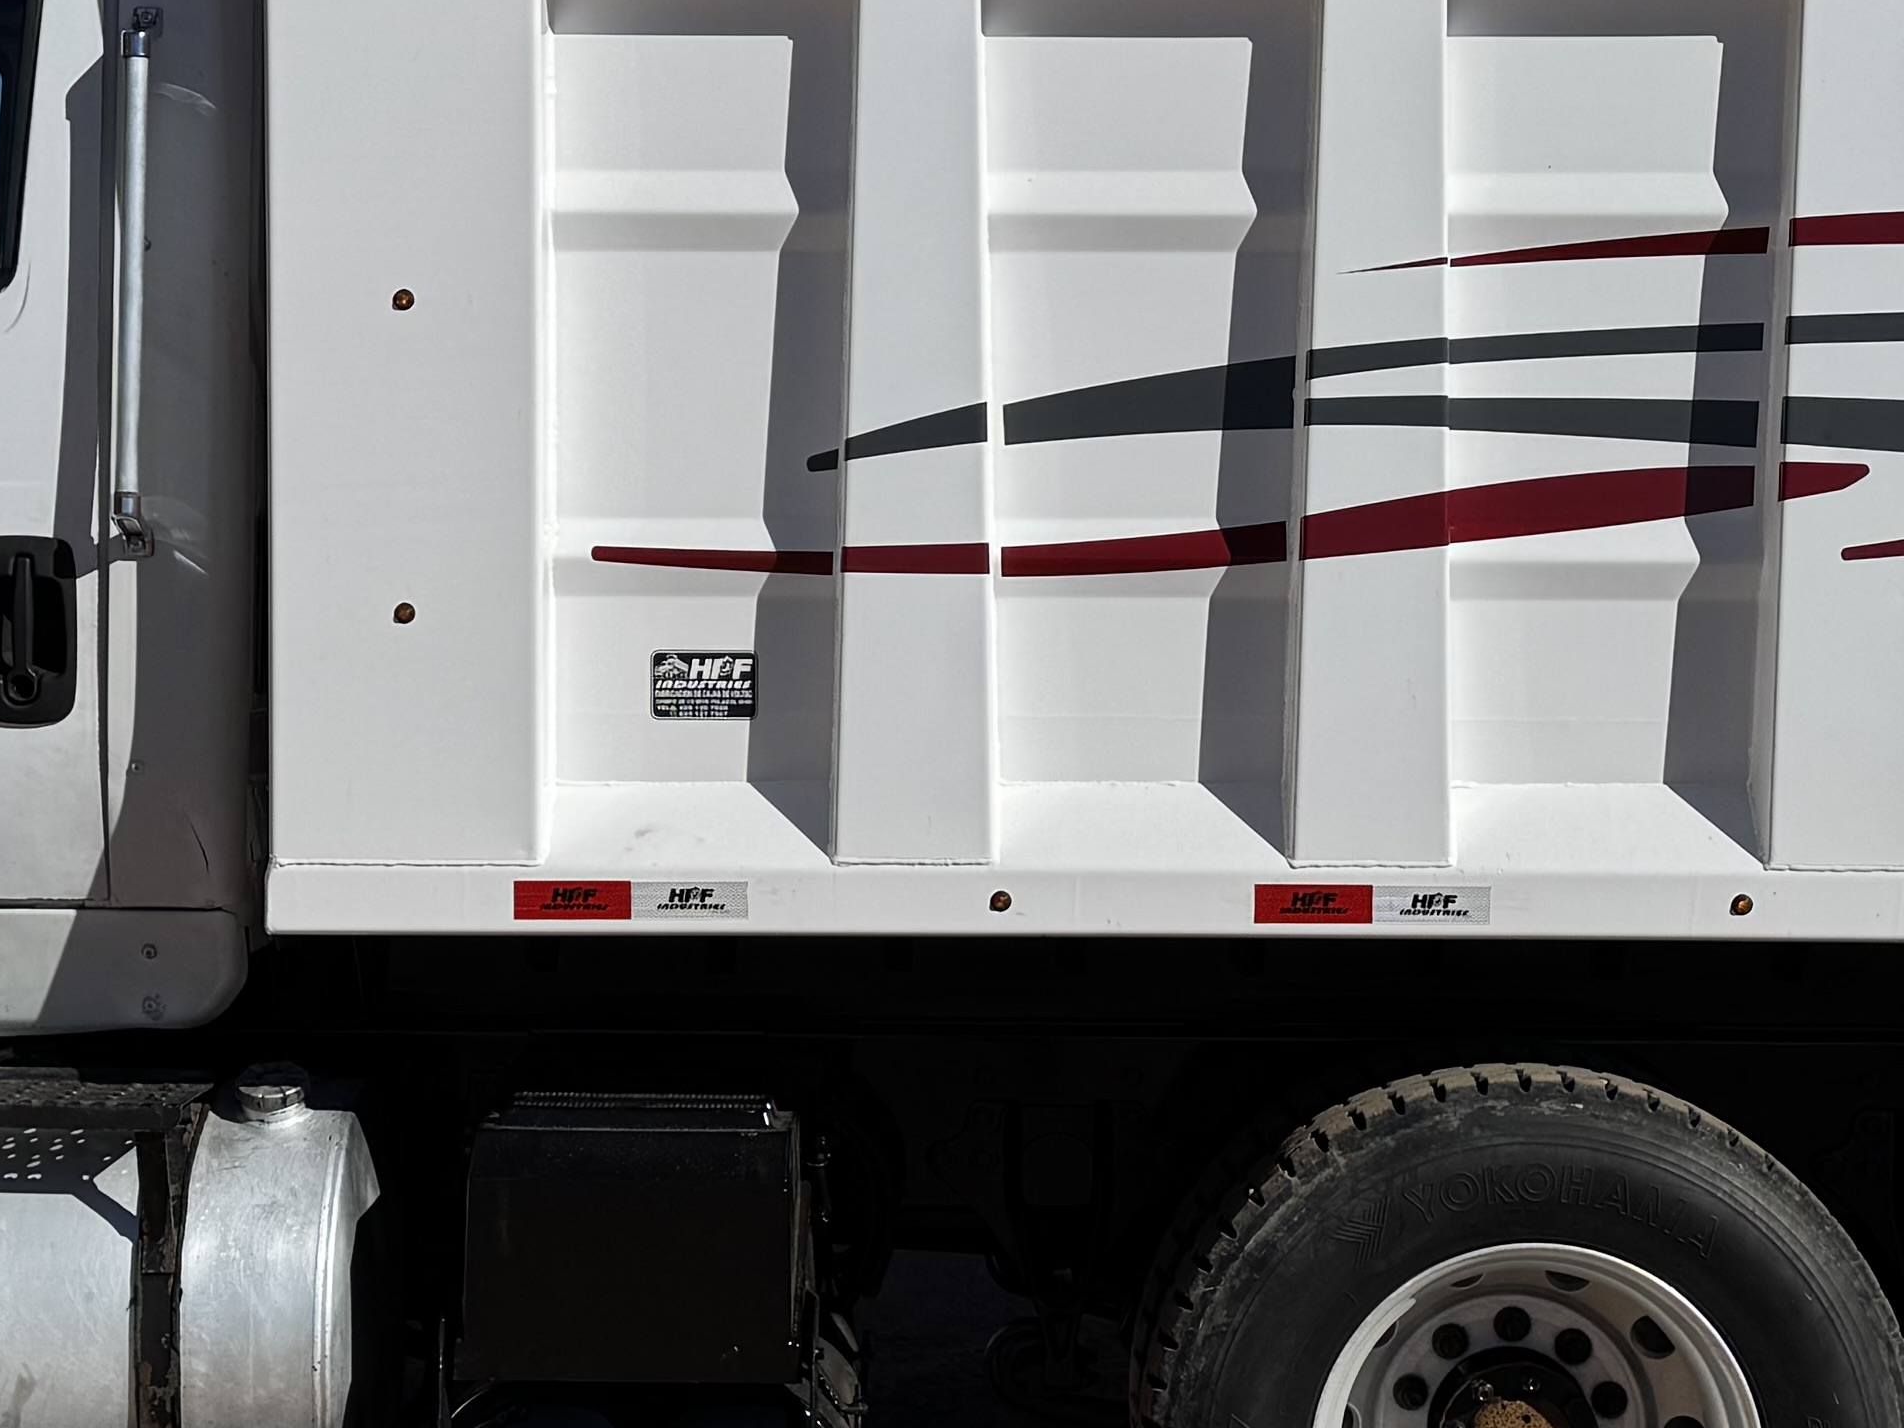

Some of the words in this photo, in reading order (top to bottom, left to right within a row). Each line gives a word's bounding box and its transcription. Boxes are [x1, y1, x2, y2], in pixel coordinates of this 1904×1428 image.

[655, 679, 753, 689] INDUSTRIES
[657, 902, 726, 911] INDUSTRIES
[1399, 908, 1469, 916] INDUSTRIES
[1405, 1162, 1720, 1258] YOKOHAMA
